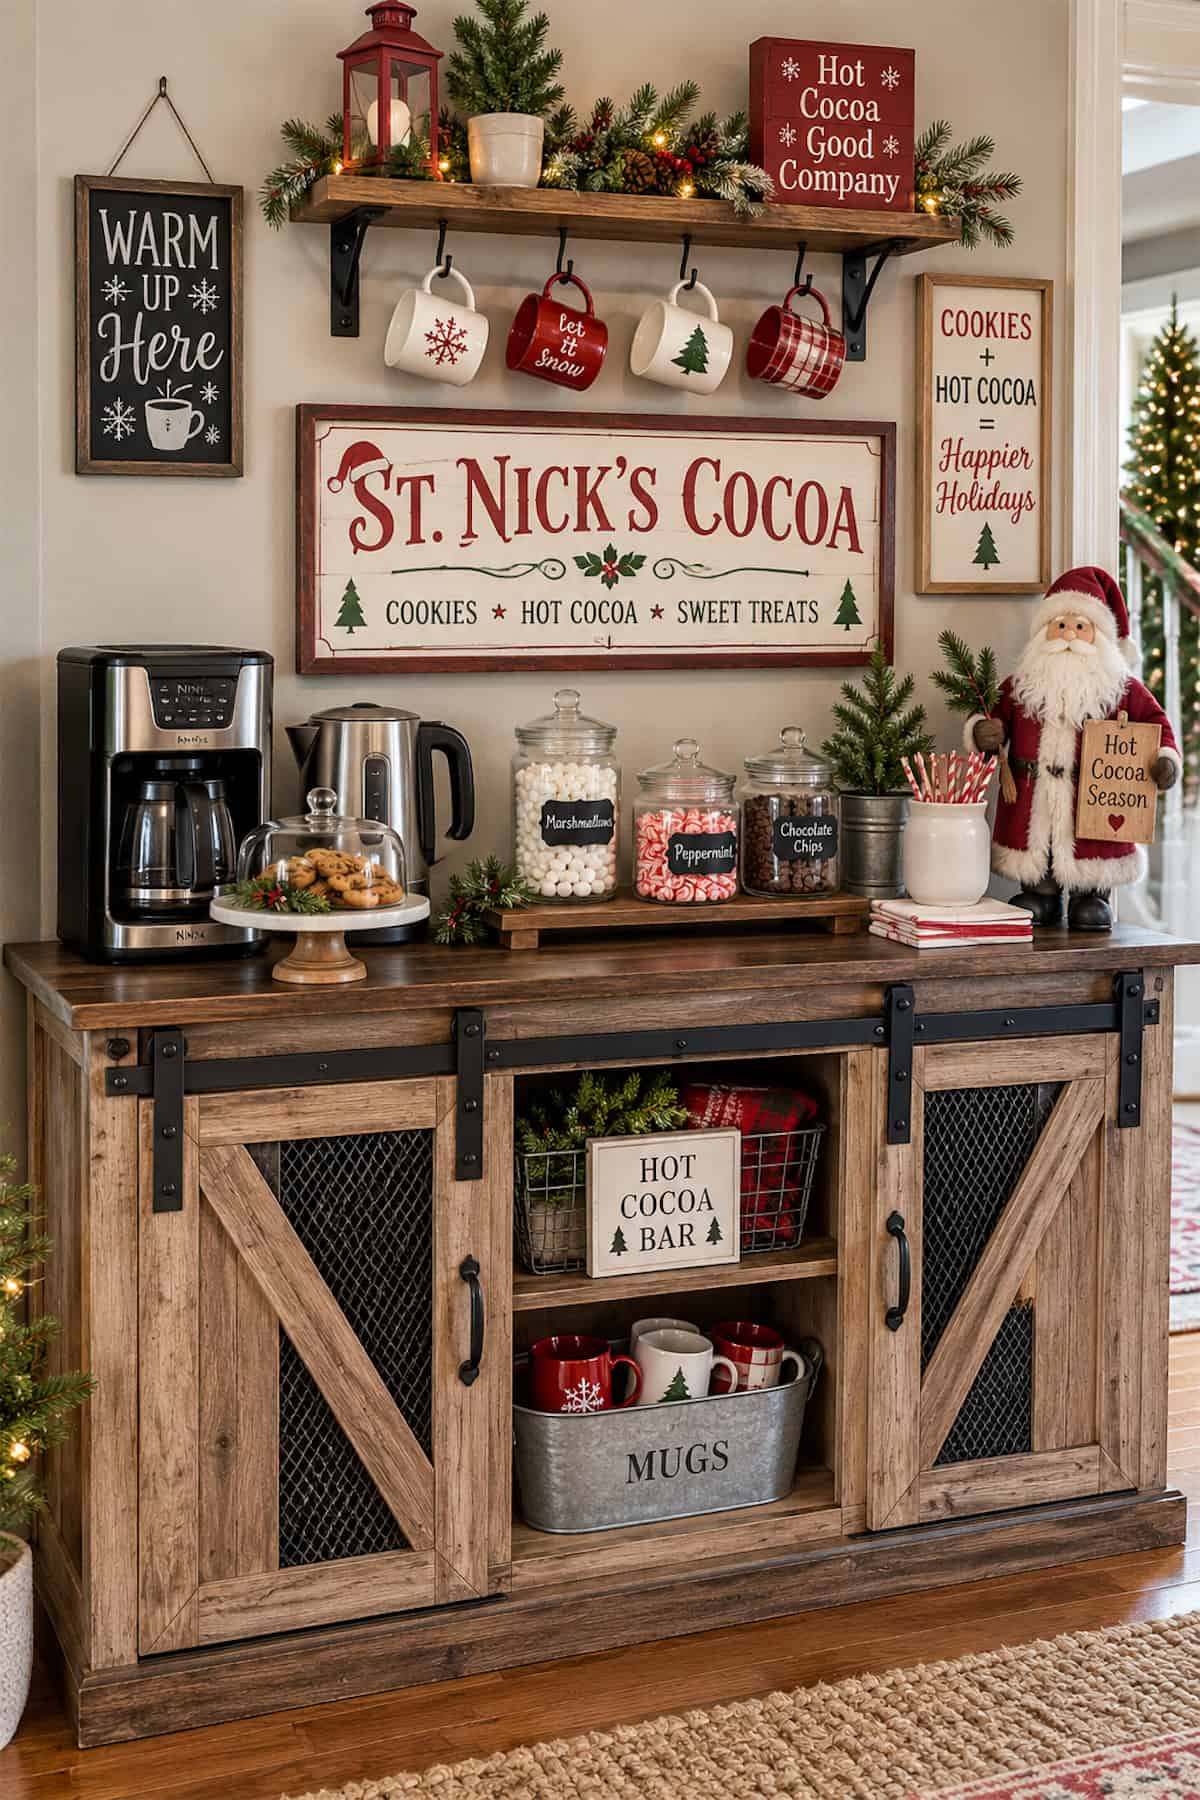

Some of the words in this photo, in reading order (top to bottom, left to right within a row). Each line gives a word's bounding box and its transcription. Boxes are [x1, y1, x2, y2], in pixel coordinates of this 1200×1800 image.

[817, 54, 866, 87] Hot
[800, 87, 881, 122] Cocoa
[806, 126, 874, 164] Good
[779, 158, 900, 203] Company
[98, 208, 219, 270] WARM
[141, 273, 180, 312] UP
[940, 308, 1033, 341] COOKIES
[97, 311, 225, 386] Here
[560, 335, 578, 357] it
[935, 375, 973, 405] HOT
[976, 376, 1037, 407] COCOA
[938, 436, 1034, 481] Happier
[935, 480, 1037, 525] Holidays
[385, 599, 478, 626] COOKIES
[520, 599, 563, 626] HOT
[569, 599, 639, 626] COCOA
[677, 599, 742, 626] SWEET
[748, 599, 819, 626] TREATS
[1104, 734, 1137, 756] Hot
[1091, 758, 1148, 782] Cocoa
[1087, 783, 1148, 809] Season
[780, 821, 833, 837] Chocolate
[674, 842, 734, 868] Peppermint
[793, 838, 824, 856] Chips
[639, 1154, 697, 1183] HOT
[620, 1187, 715, 1219] COCOA
[639, 1223, 697, 1252] BAR
[625, 1440, 729, 1485] MUGS
